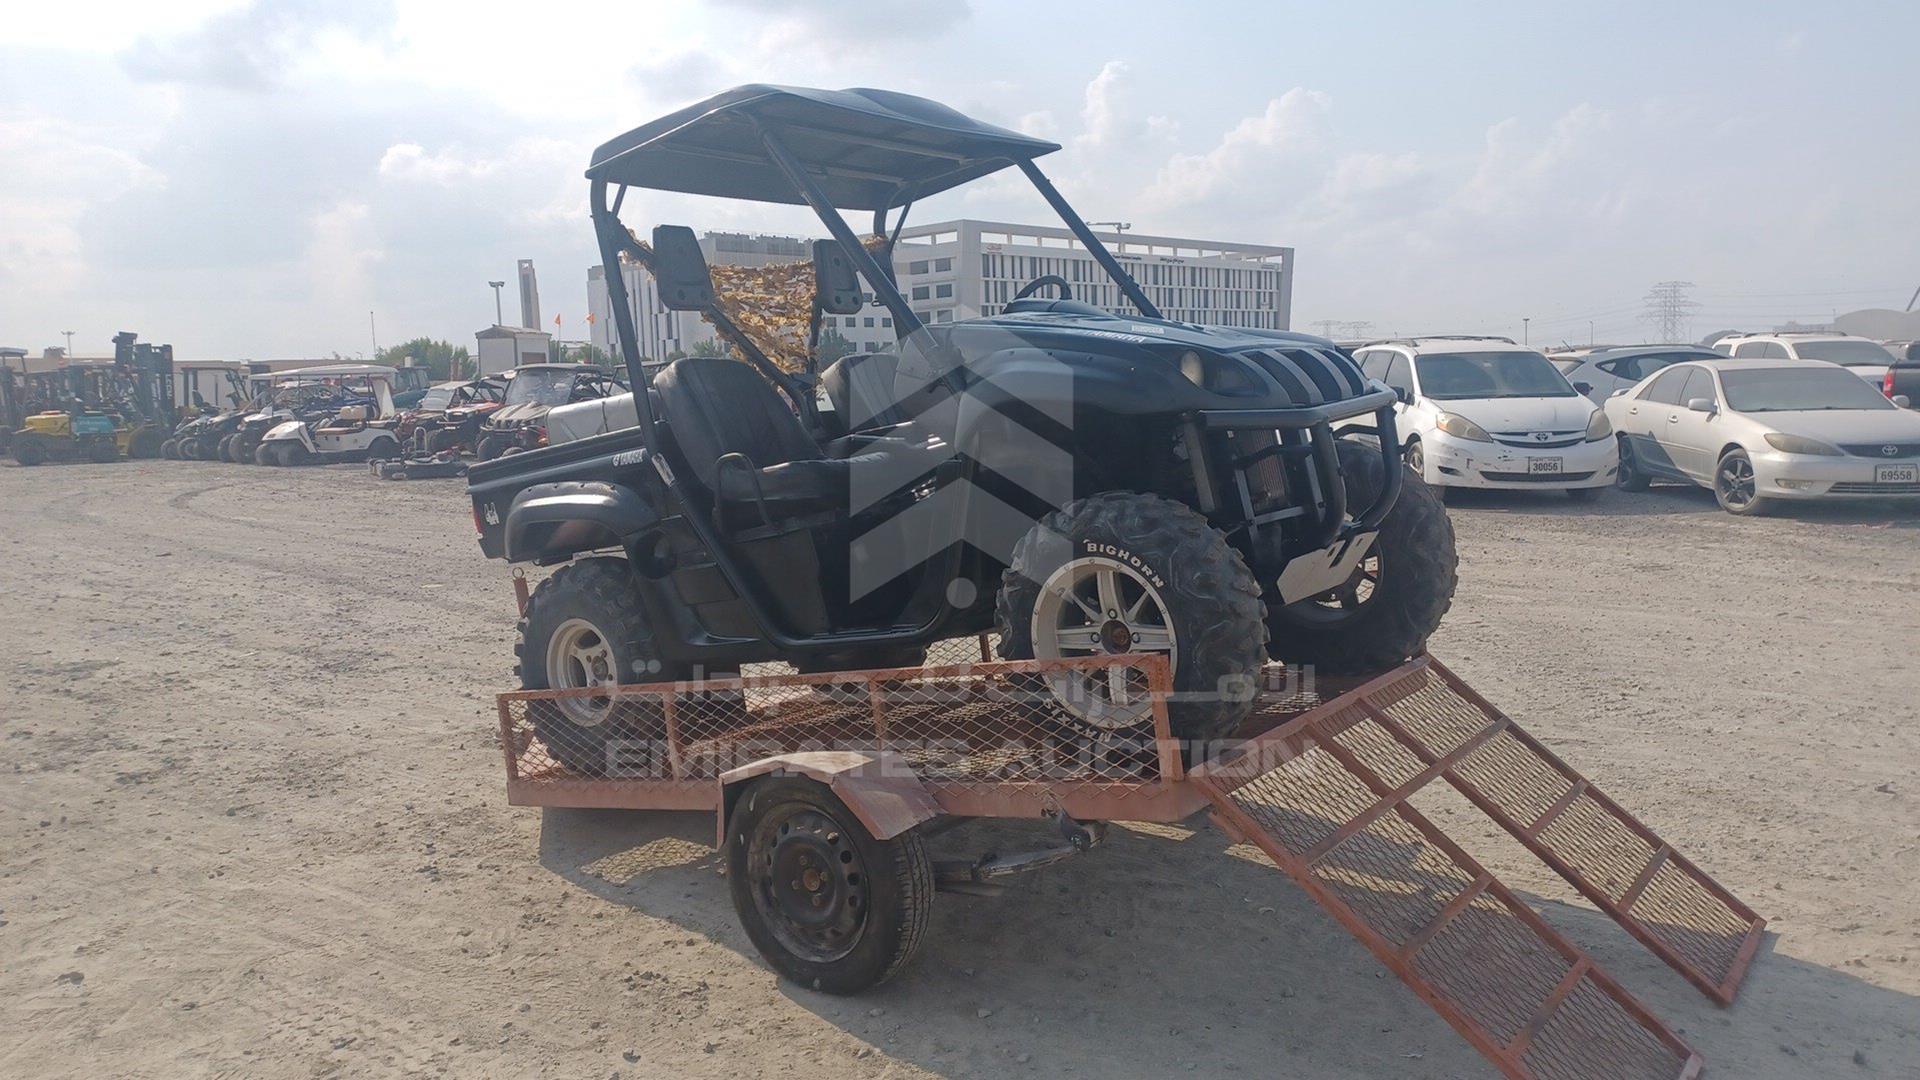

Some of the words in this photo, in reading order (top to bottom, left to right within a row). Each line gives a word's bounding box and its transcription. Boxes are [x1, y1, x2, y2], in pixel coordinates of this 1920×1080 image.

[1533, 462, 1558, 472] 30056
[1881, 470, 1912, 481] 69558
[1086, 542, 1165, 588] BIGHORN
